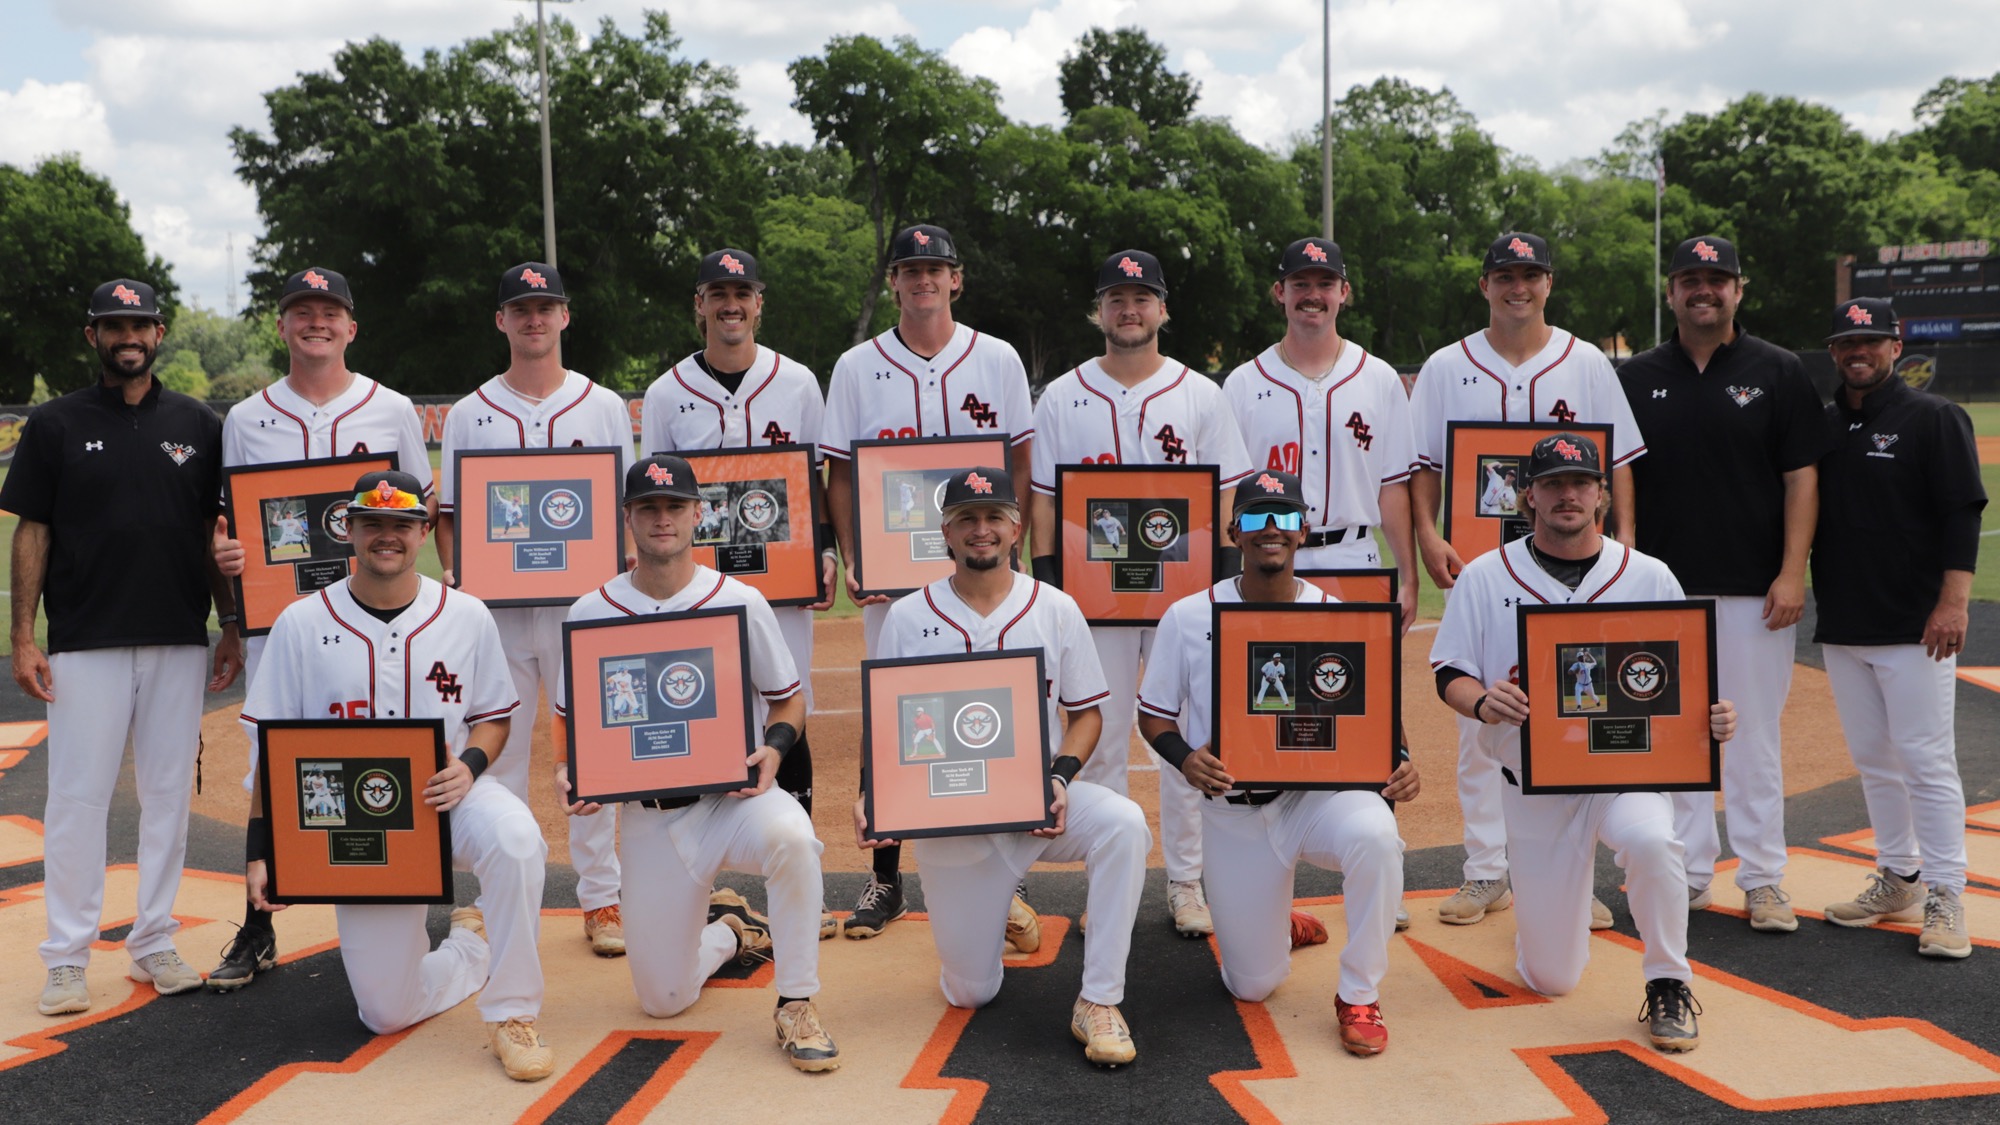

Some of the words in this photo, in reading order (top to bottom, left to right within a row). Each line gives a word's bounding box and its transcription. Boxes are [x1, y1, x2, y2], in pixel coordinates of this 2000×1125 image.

[961, 393, 998, 429] AUM
[1345, 411, 1374, 451] AUM
[1153, 424, 1189, 464] AUM
[1266, 441, 1299, 475] 40
[426, 661, 464, 704] AUM
